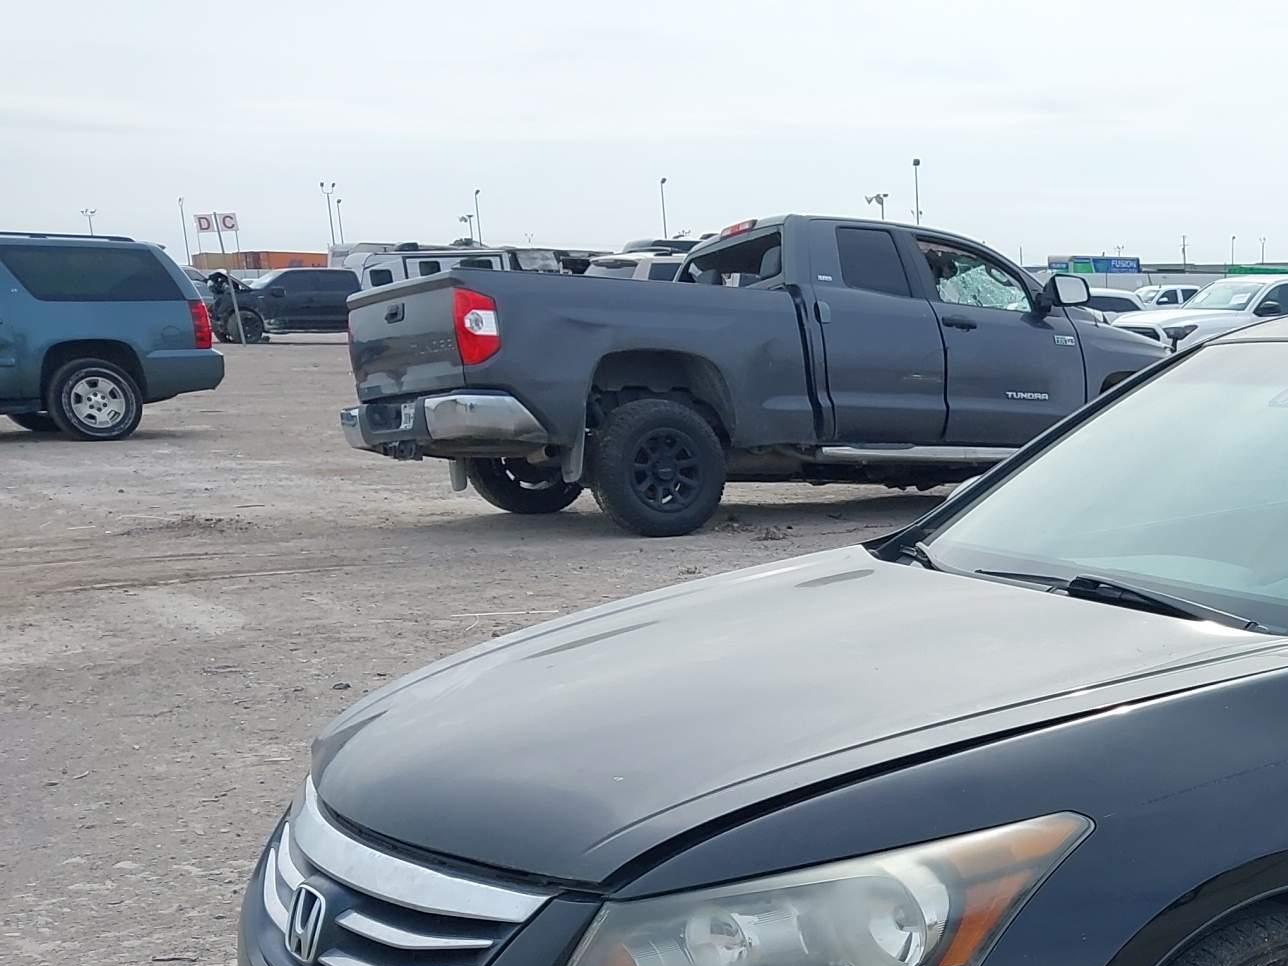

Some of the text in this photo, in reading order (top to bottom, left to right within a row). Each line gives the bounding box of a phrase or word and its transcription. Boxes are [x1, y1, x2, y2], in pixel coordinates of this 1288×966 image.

[198, 217, 210, 230] D
[222, 216, 235, 229] C
[1006, 391, 1049, 400] TUNDRA
